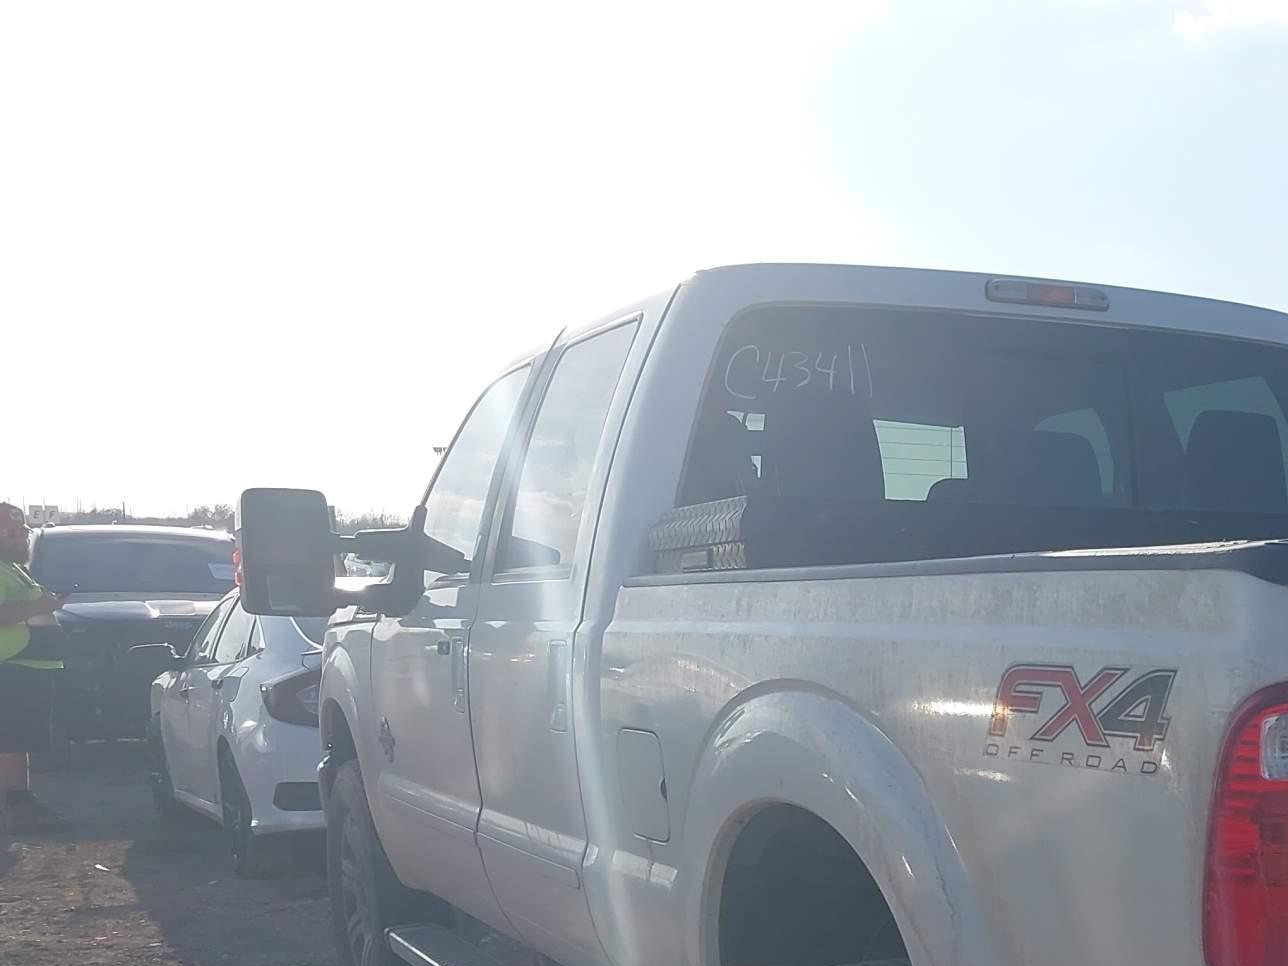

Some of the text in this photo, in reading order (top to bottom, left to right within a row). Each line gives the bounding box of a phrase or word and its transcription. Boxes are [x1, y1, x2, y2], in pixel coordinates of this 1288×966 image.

[724, 344, 873, 399] C43411
[989, 664, 1178, 752] FX4
[983, 744, 1158, 774] OFF ROAD
